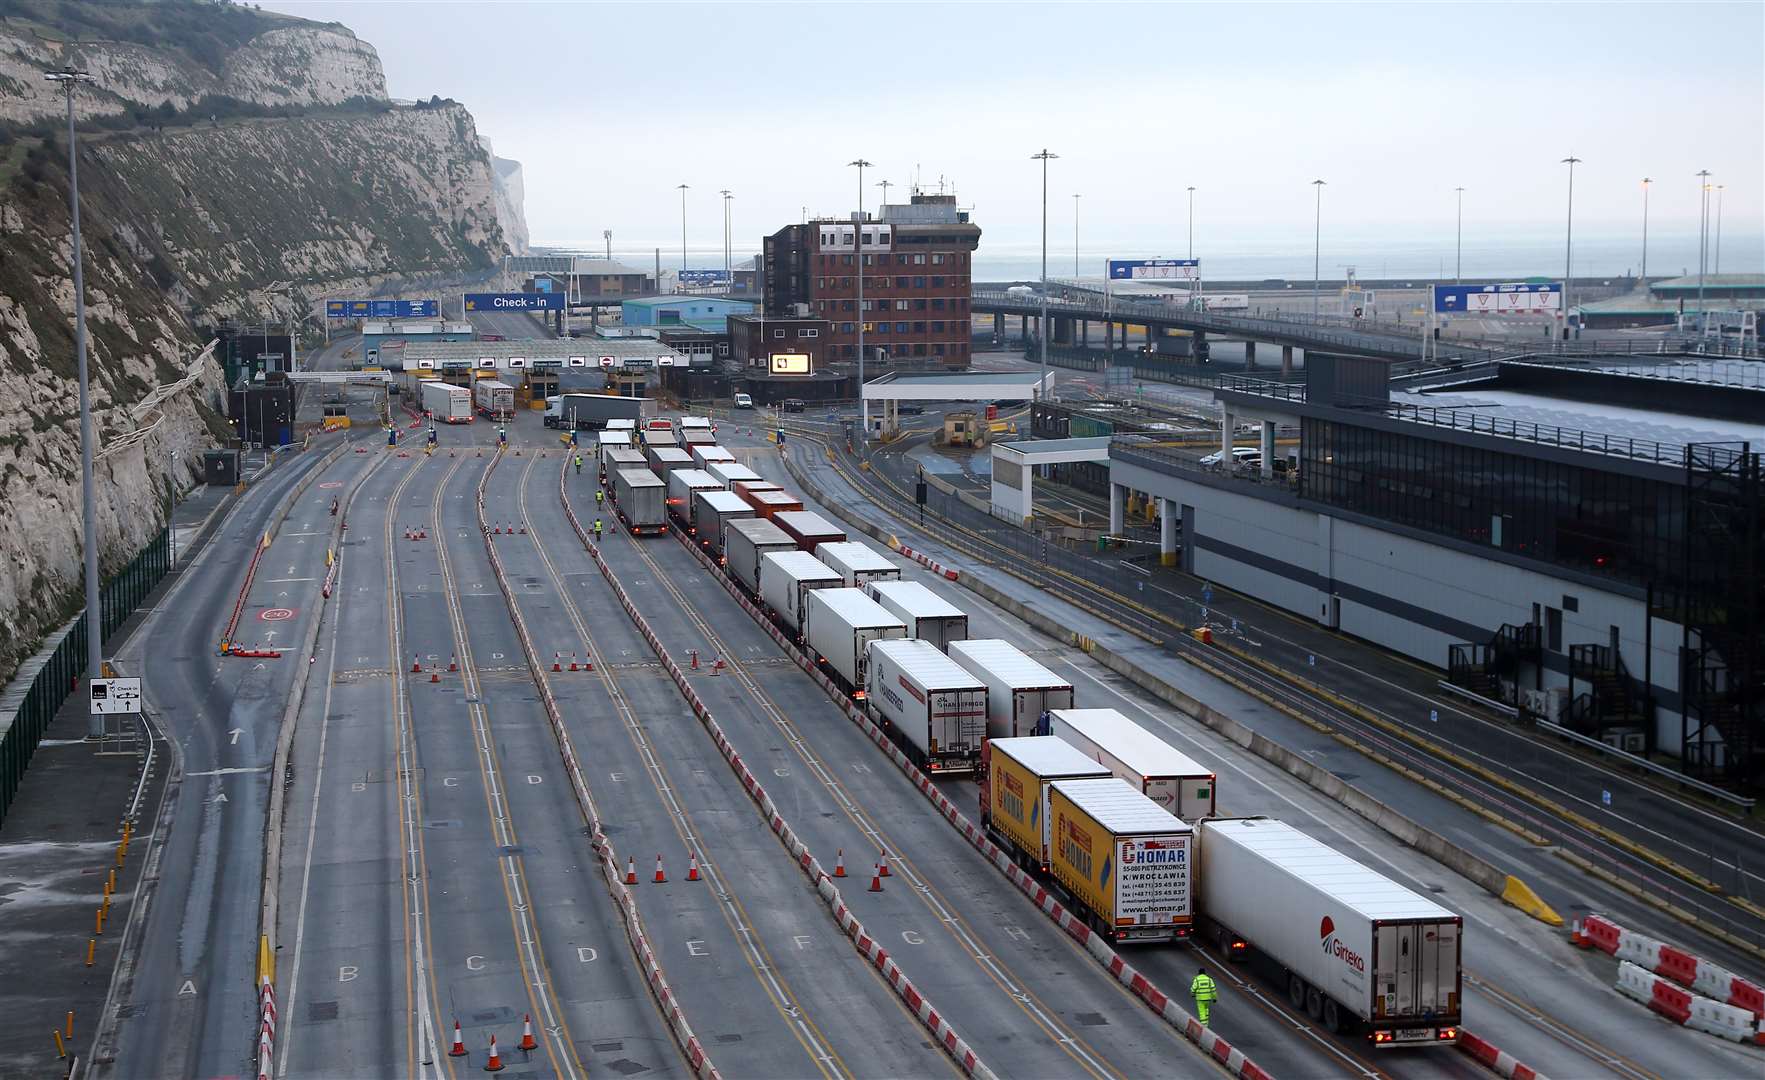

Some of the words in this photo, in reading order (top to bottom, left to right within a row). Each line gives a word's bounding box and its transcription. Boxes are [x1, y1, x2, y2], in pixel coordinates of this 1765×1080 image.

[493, 297, 527, 307] Check
[537, 297, 547, 307] in
[351, 783, 366, 792] B
[443, 777, 459, 787] C
[527, 775, 543, 785] D
[1058, 812, 1093, 883] CHOMAR
[1122, 841, 1186, 864] CHOMAR
[1122, 904, 1186, 913] www.chomar.pl
[902, 930, 924, 945] G
[1004, 926, 1031, 941] H
[686, 940, 709, 956] E
[793, 935, 811, 949] F
[466, 955, 486, 970] C
[577, 947, 598, 963] D
[1333, 938, 1365, 972] Girteka
[338, 966, 358, 982] B
[177, 979, 198, 995] A
